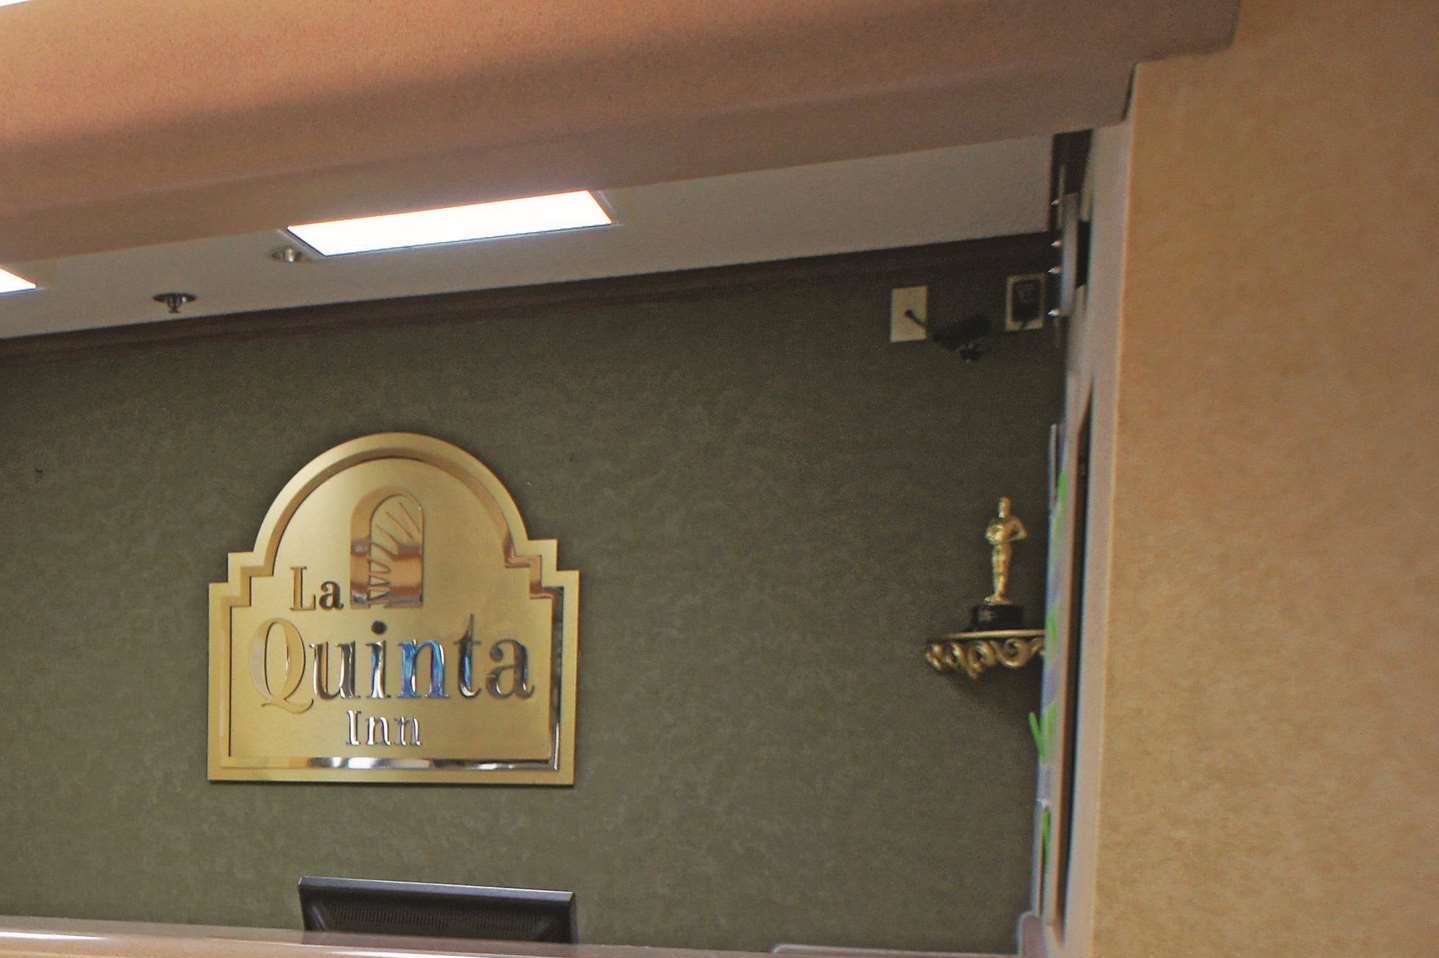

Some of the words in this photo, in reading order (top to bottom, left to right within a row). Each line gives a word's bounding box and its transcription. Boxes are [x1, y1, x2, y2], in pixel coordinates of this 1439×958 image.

[290, 566, 344, 611] La
[251, 614, 535, 714] Quinta
[345, 710, 423, 746] Inn
